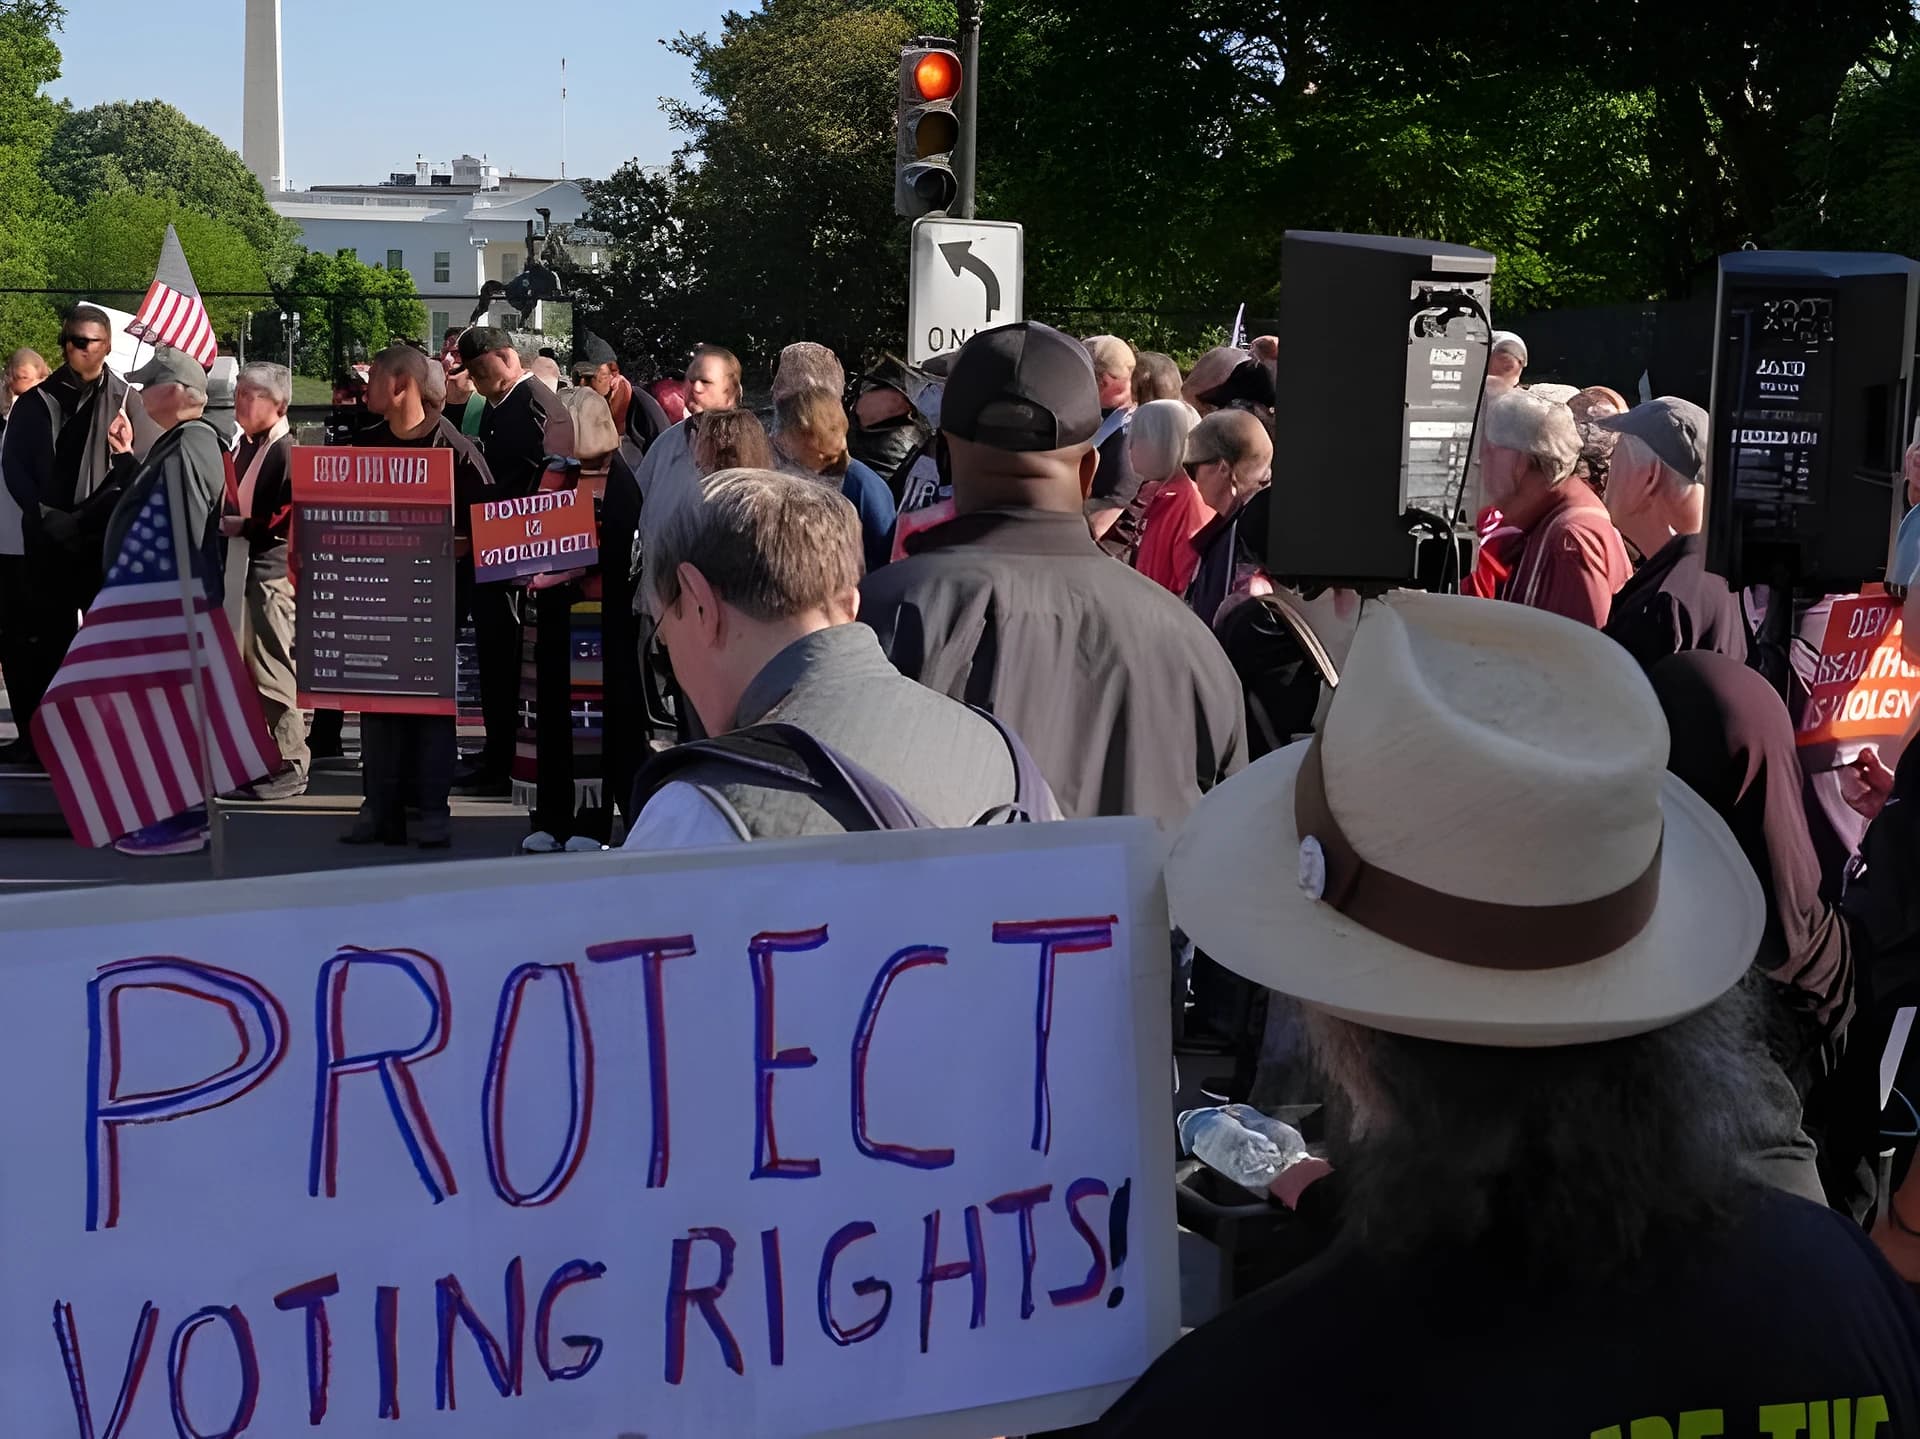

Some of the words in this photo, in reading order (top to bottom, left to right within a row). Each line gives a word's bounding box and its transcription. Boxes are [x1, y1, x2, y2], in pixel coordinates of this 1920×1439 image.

[928, 326, 977, 351] ON
[85, 915, 1119, 1231] PROTECT
[53, 1256, 607, 1439] VOTING
[665, 1177, 1131, 1386] RIGHTS!
